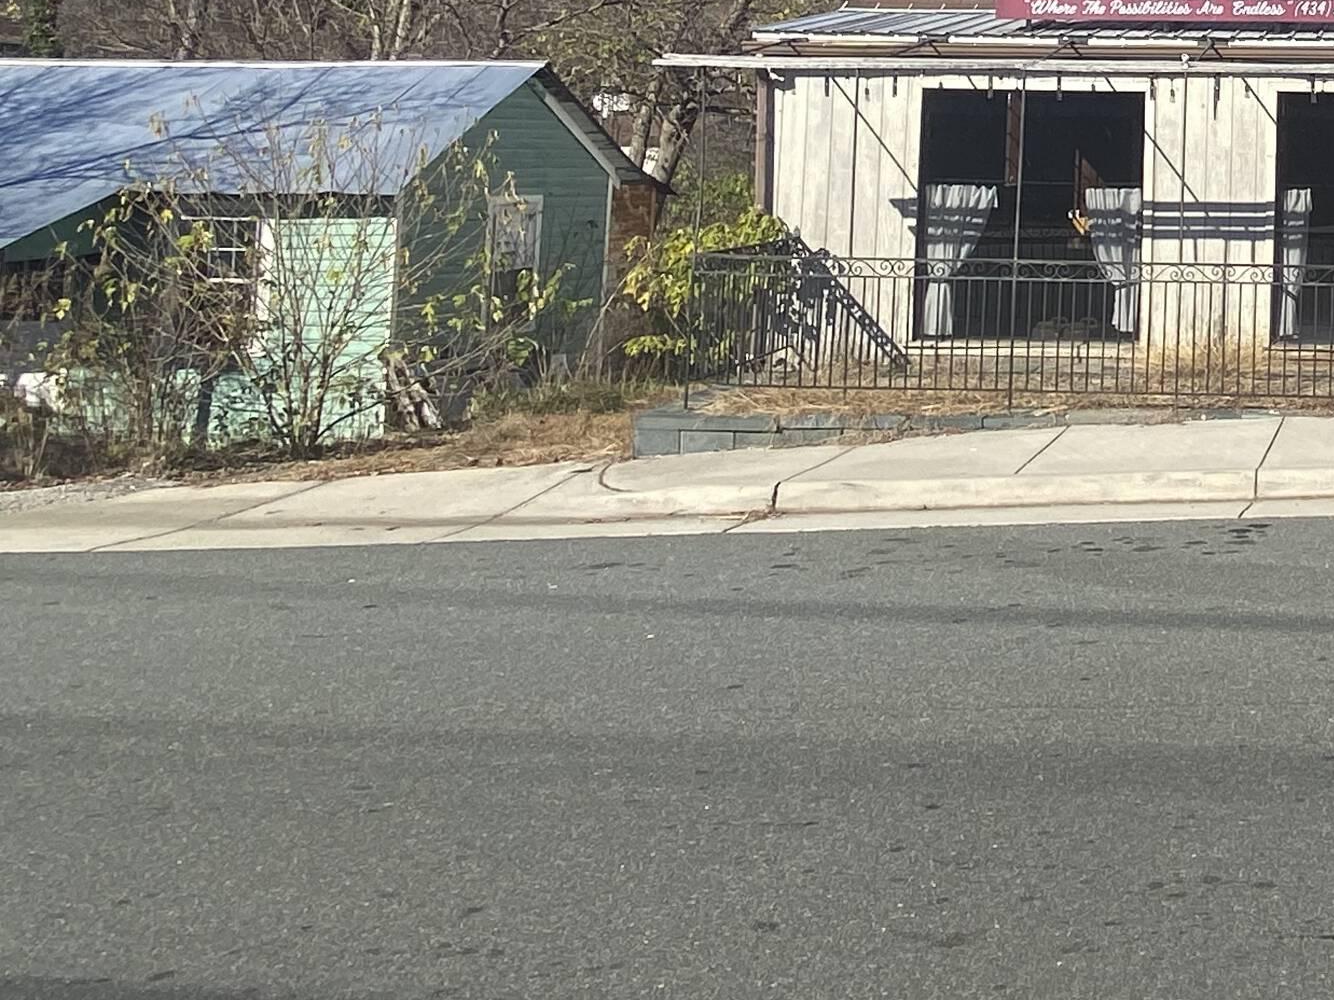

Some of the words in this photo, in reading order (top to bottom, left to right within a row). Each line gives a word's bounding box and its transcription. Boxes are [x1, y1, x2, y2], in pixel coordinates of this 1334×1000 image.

[1081, 0, 1107, 15] The
[1109, 0, 1193, 15] Possibilities
[1196, 0, 1225, 15] Are
[1294, 0, 1332, 17] (434)
